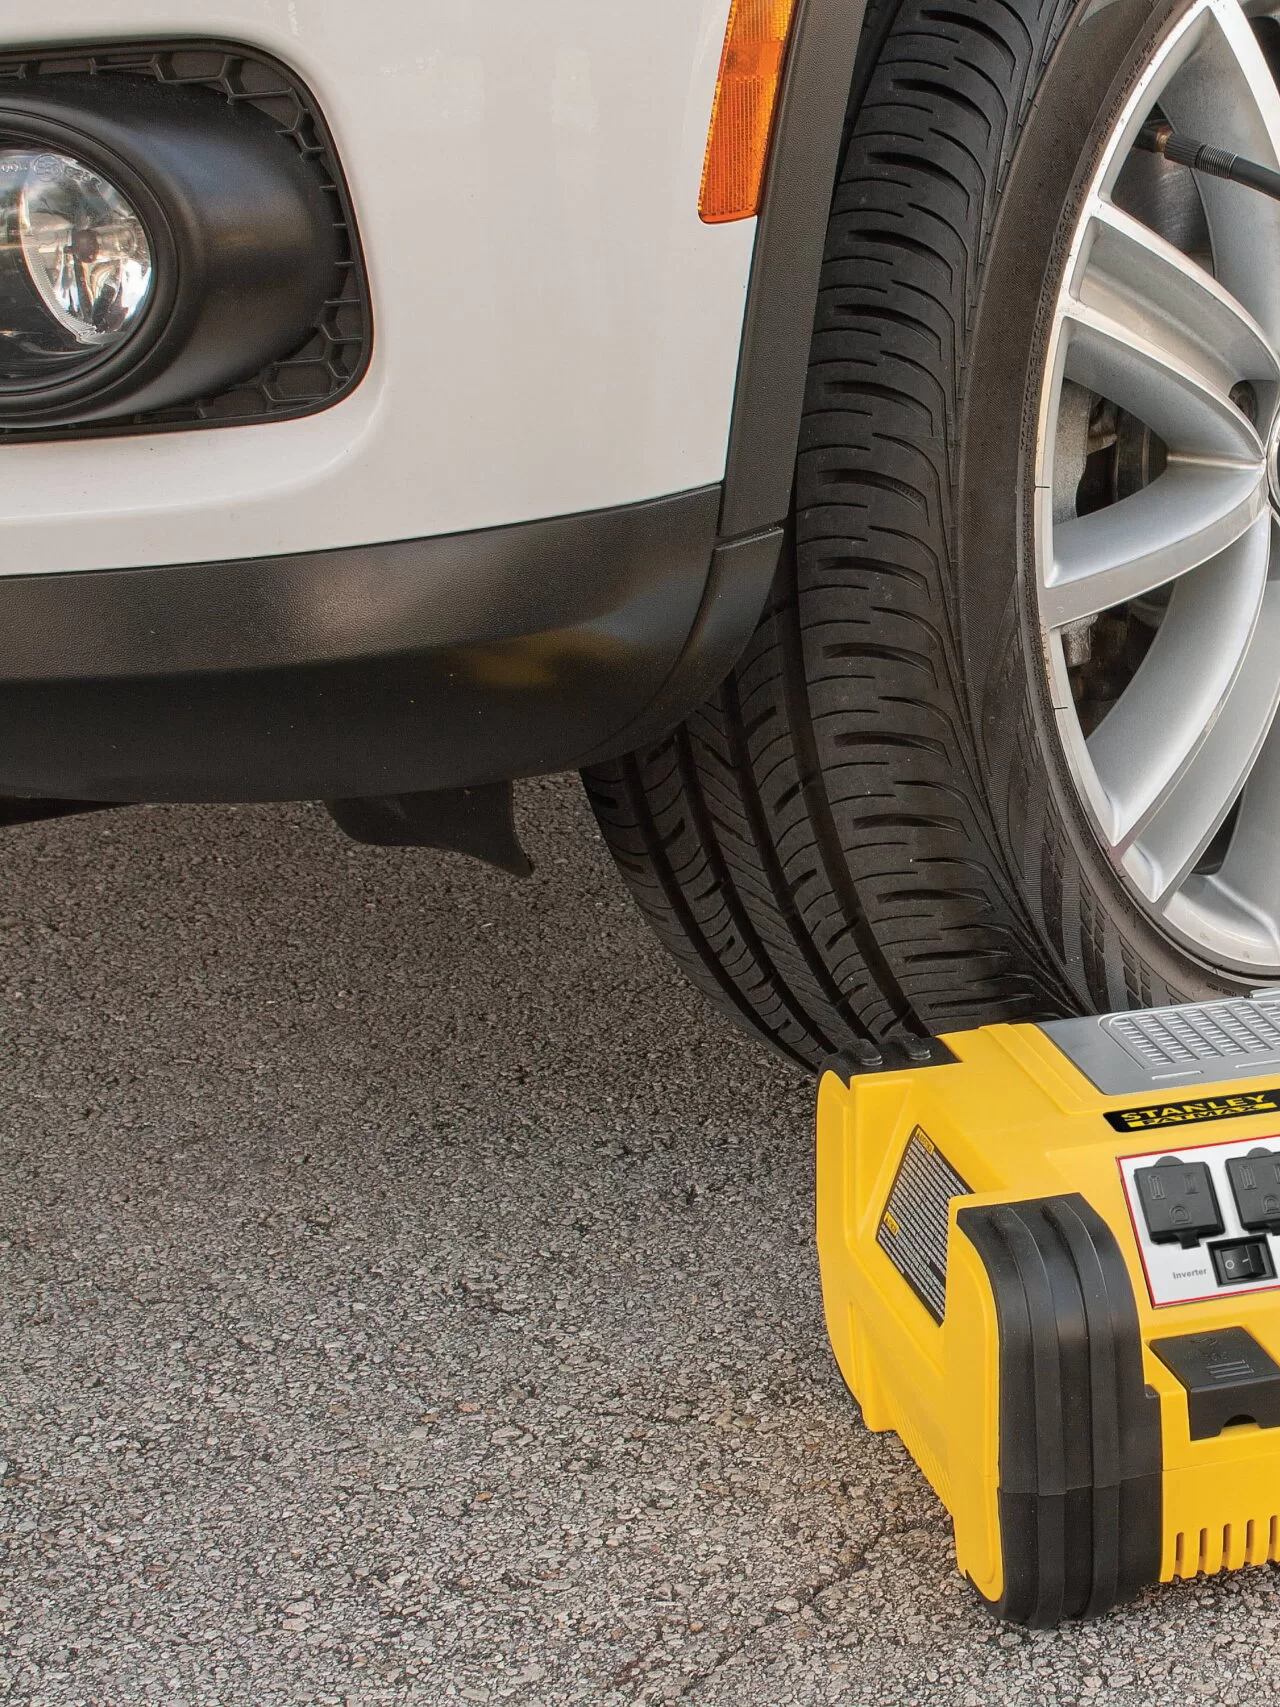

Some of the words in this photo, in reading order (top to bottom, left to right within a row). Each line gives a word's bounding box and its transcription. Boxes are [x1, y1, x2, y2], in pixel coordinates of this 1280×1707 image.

[1121, 1094, 1265, 1122] STANLEY
[1141, 1104, 1259, 1126] FATMAX
[1172, 1267, 1207, 1280] Inverter
